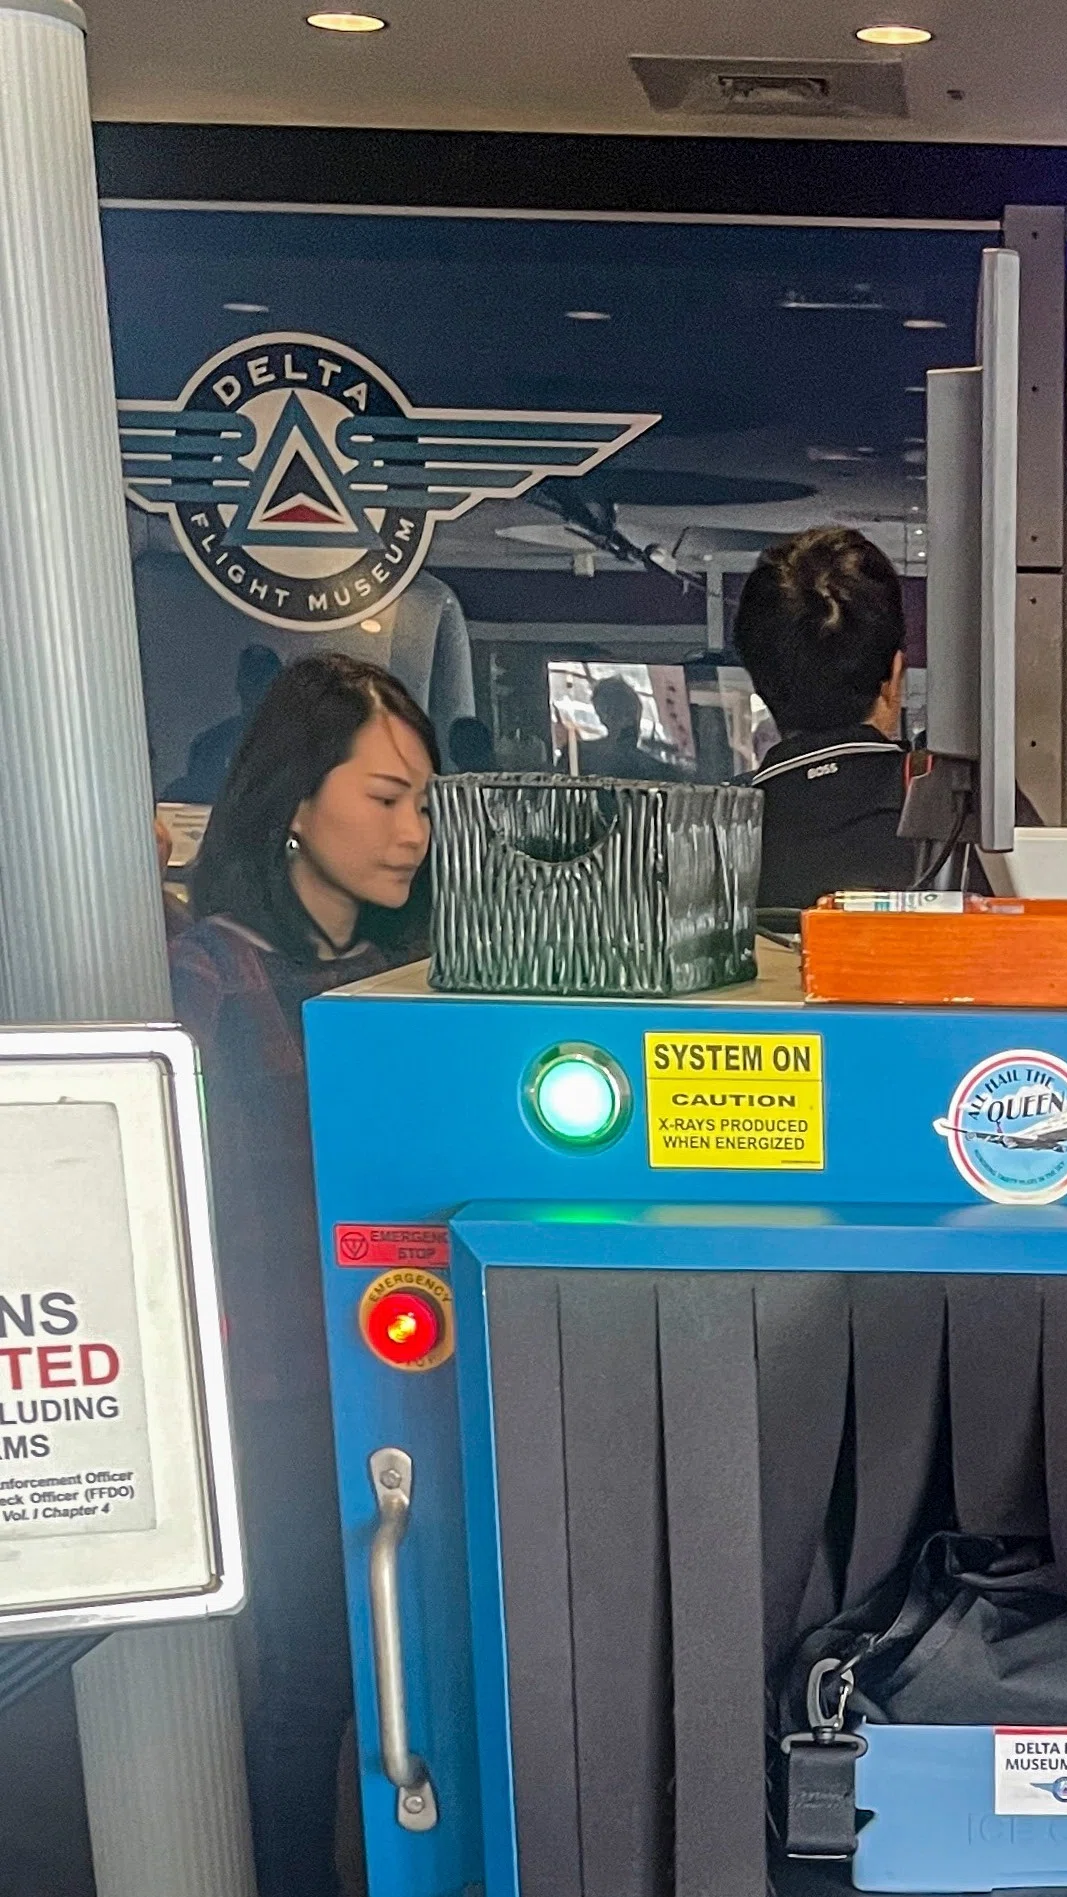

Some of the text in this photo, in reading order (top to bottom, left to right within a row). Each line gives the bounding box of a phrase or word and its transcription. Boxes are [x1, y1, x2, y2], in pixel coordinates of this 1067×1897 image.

[212, 354, 369, 412] DELTA
[191, 512, 415, 612] FLIGHT MUSEUM
[807, 763, 839, 779] BOSS
[654, 1044, 811, 1072] SYSTEM ON
[672, 1093, 795, 1107] CAUTION
[968, 1069, 1055, 1120] ALL HAIL THE
[987, 1092, 1065, 1125] QUEEN
[658, 1118, 808, 1133] X-RAYS PRODUCED
[663, 1136, 805, 1150] WHEN ENERGIZED
[371, 1231, 448, 1243] EMERGENC
[398, 1247, 436, 1259] STOP
[369, 1273, 452, 1302] EMERGENCY
[0, 1343, 120, 1390] TED
[85, 1471, 134, 1484] Officer
[30, 1490, 79, 1503] Officer
[84, 1485, 134, 1502] (FFDO)
[42, 1504, 98, 1519] Chapter
[101, 1502, 111, 1514] 4
[1015, 1742, 1060, 1755] DELTA
[968, 1812, 1033, 1846] ICE
